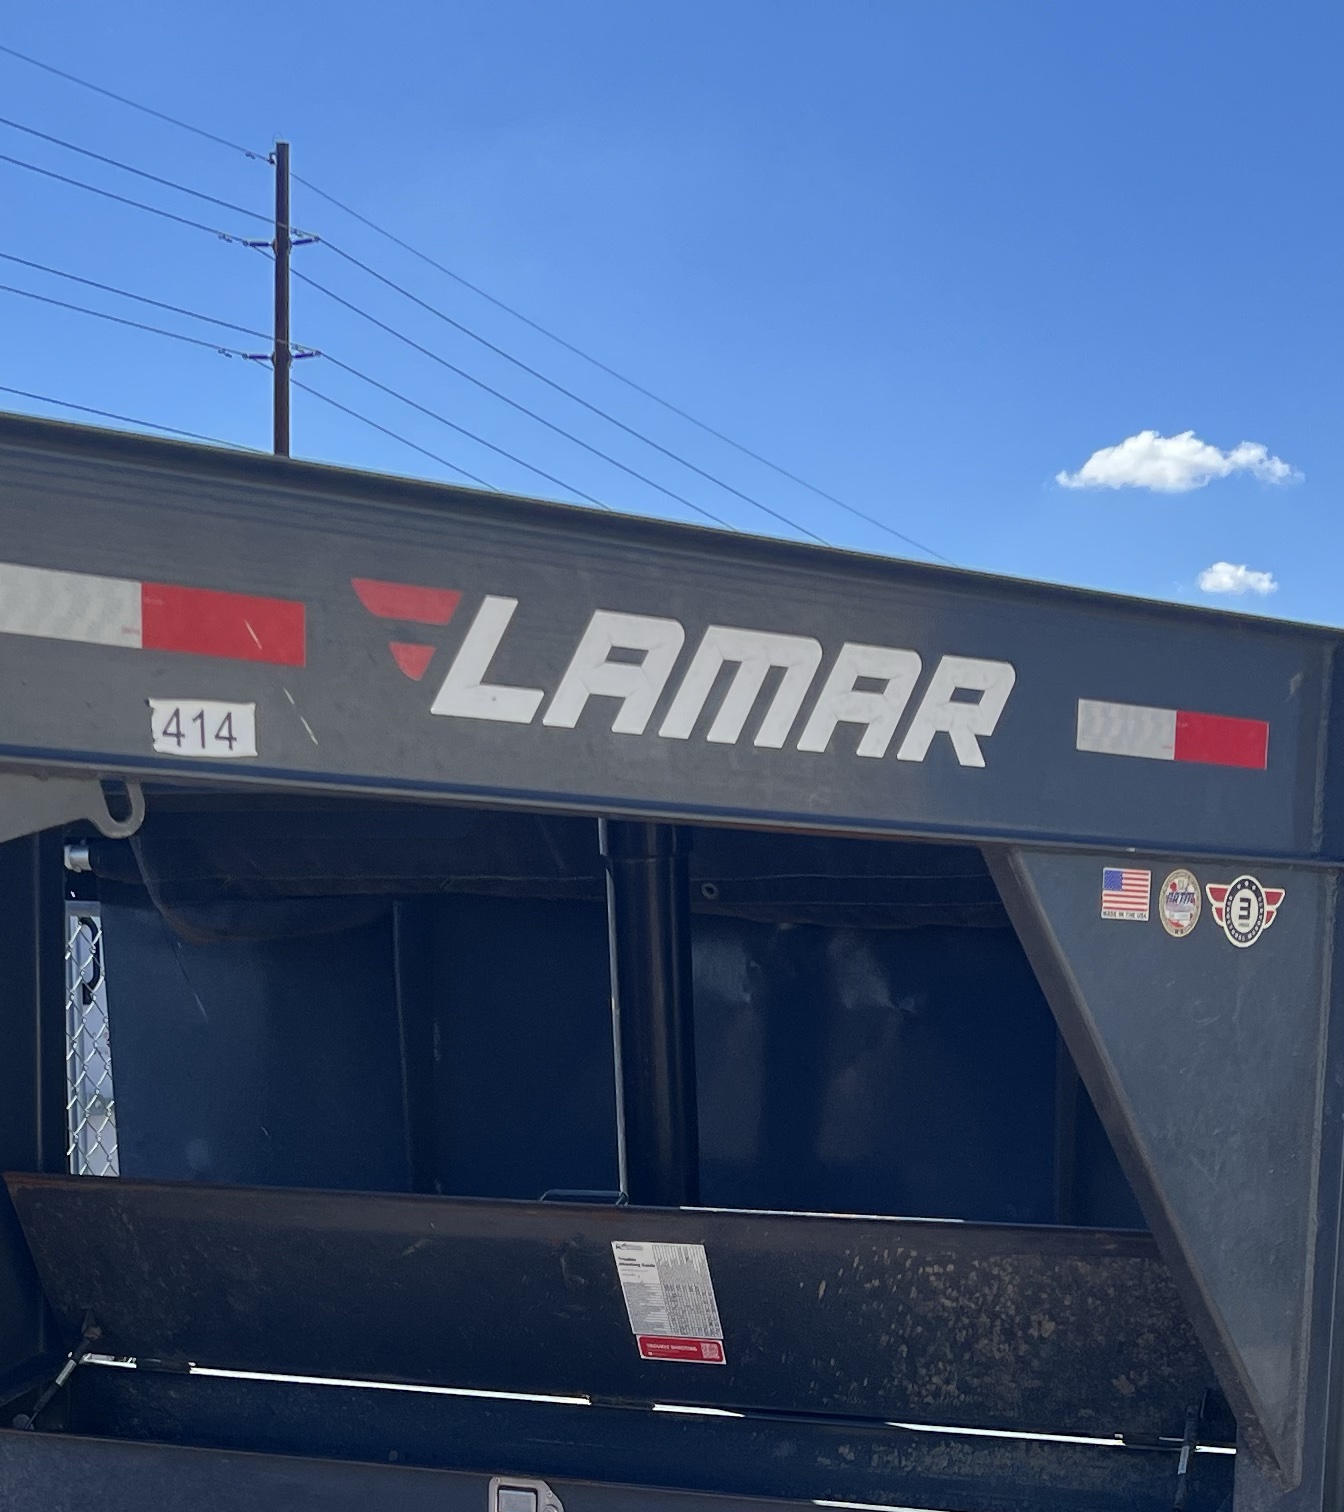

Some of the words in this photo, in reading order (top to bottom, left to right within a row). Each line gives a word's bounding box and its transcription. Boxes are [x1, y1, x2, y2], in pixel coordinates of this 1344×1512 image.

[430, 594, 1016, 768] LAMAR
[162, 707, 238, 751] 414
[1238, 897, 1252, 921] 3
